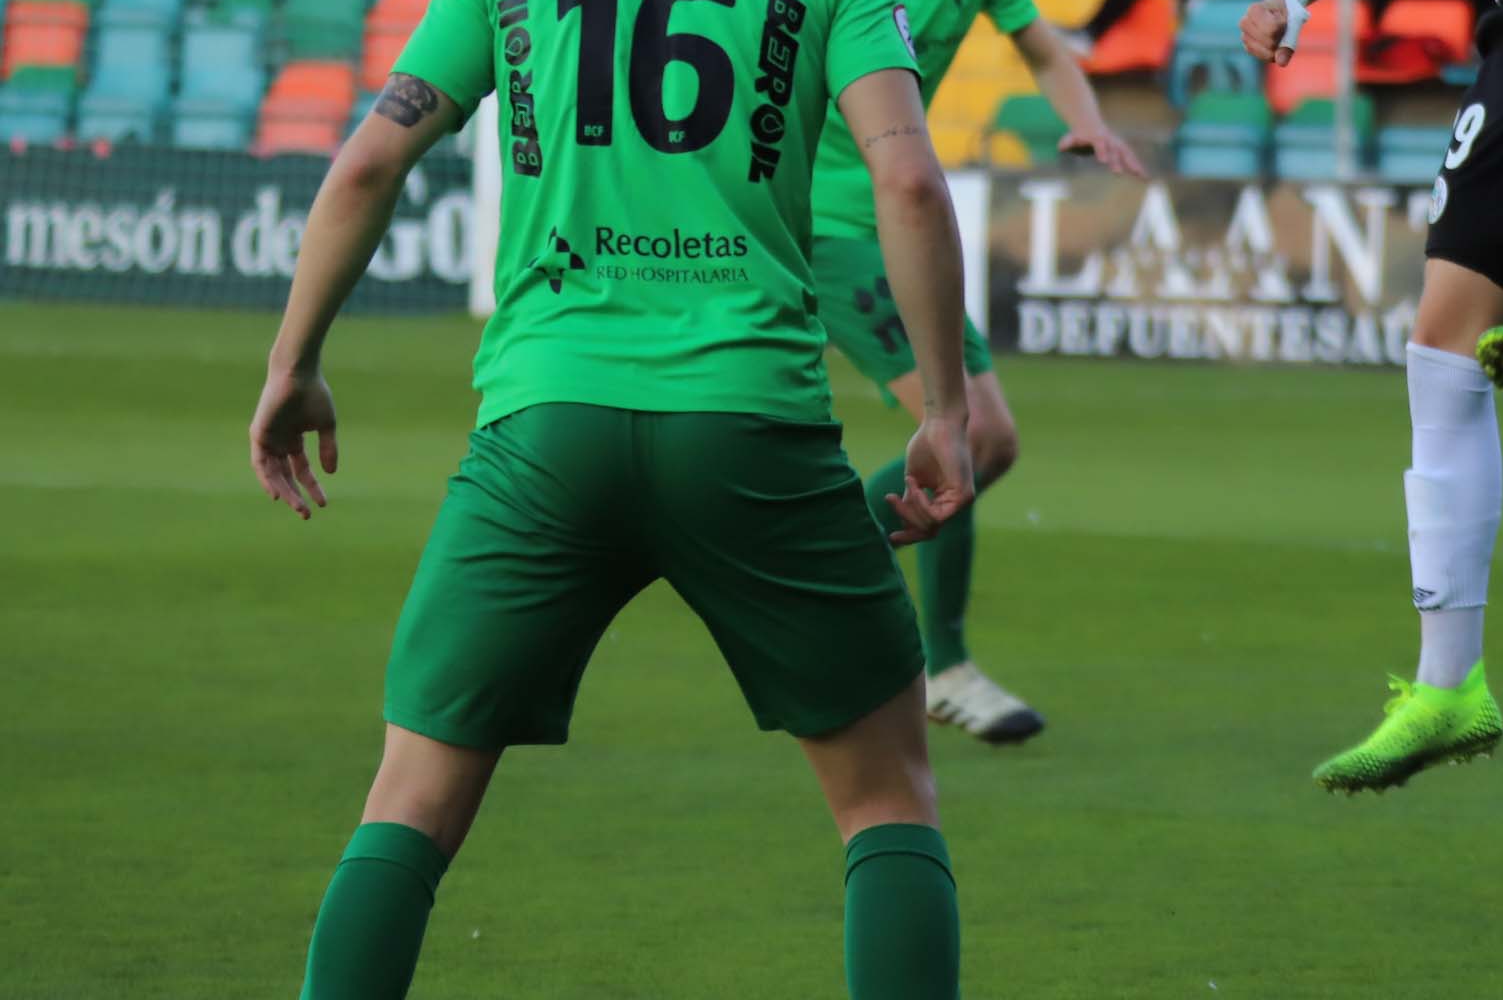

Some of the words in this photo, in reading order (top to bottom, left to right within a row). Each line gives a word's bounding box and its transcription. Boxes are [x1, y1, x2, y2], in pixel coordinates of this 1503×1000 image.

[1445, 103, 1486, 169] 9
[6, 186, 223, 275] mesón
[233, 186, 304, 278] de
[595, 226, 748, 259] Recoletas
[597, 265, 628, 281] RED
[632, 266, 749, 284] HOSPITALARIA
